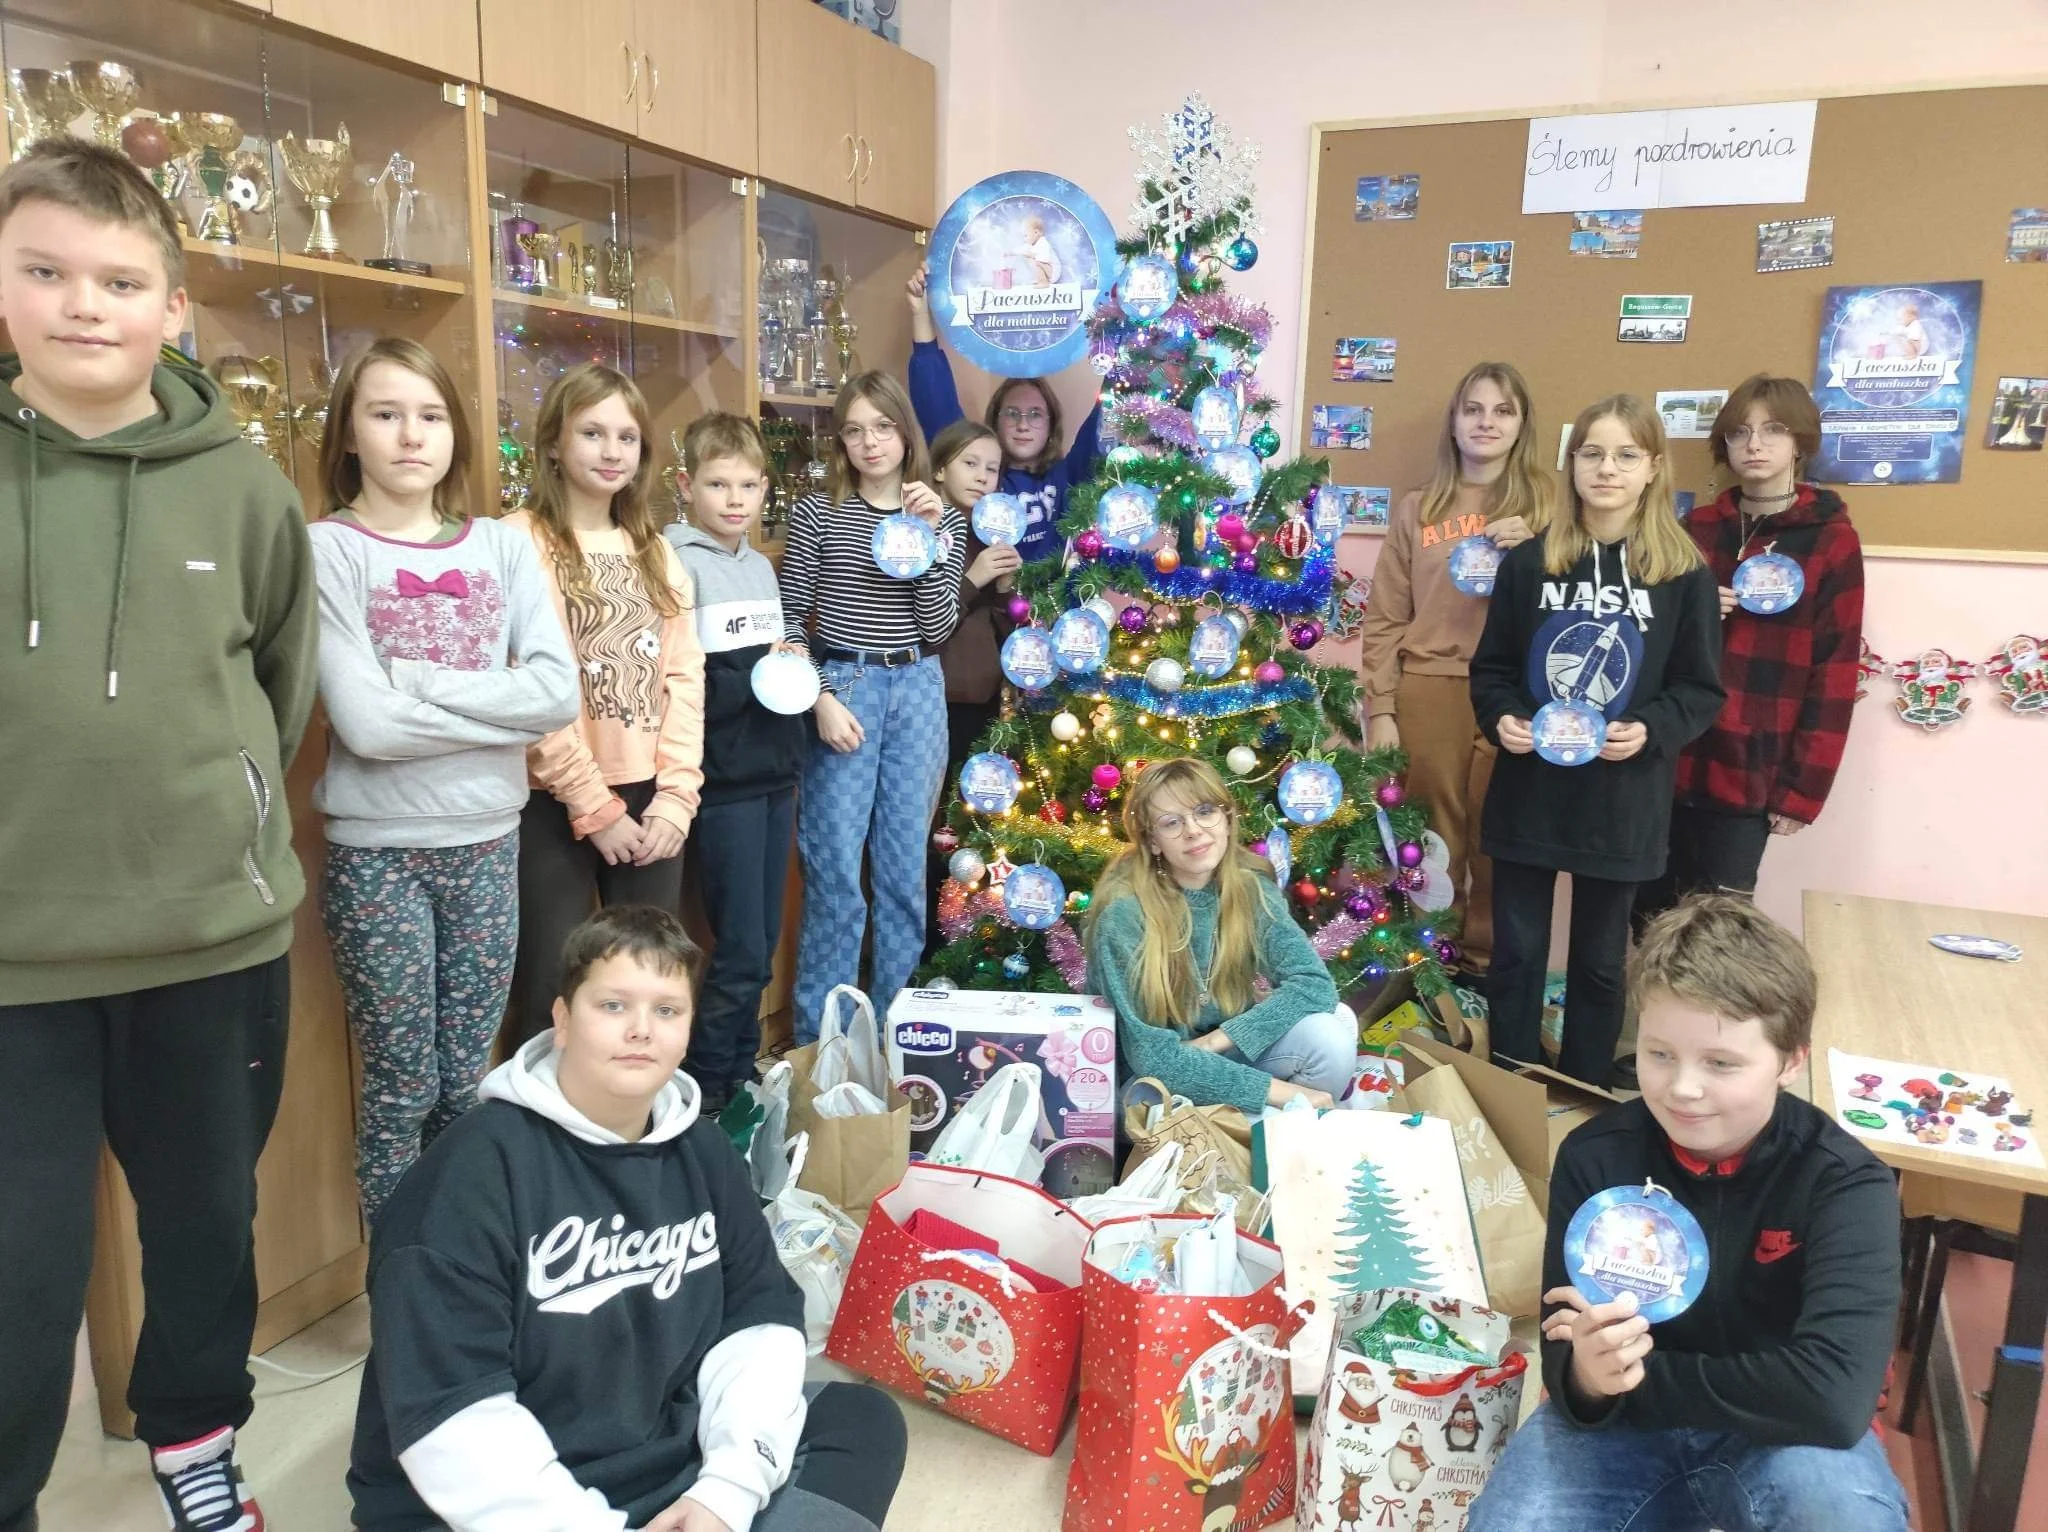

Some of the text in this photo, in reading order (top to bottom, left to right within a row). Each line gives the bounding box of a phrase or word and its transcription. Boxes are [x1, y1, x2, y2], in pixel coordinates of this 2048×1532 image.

[1528, 127, 1796, 193] Ślemy pozdrowienia
[973, 287, 1073, 311] Paczuszka
[983, 312, 1068, 328] dla maluszka
[588, 553, 624, 566] YOUR
[1538, 581, 1655, 619] NASA
[726, 616, 747, 634] 4F
[898, 1023, 950, 1047] chicco
[1080, 1072, 1097, 1084] 20
[527, 1211, 717, 1300] Chicago
[1390, 1398, 1444, 1422] CHRISTMAS
